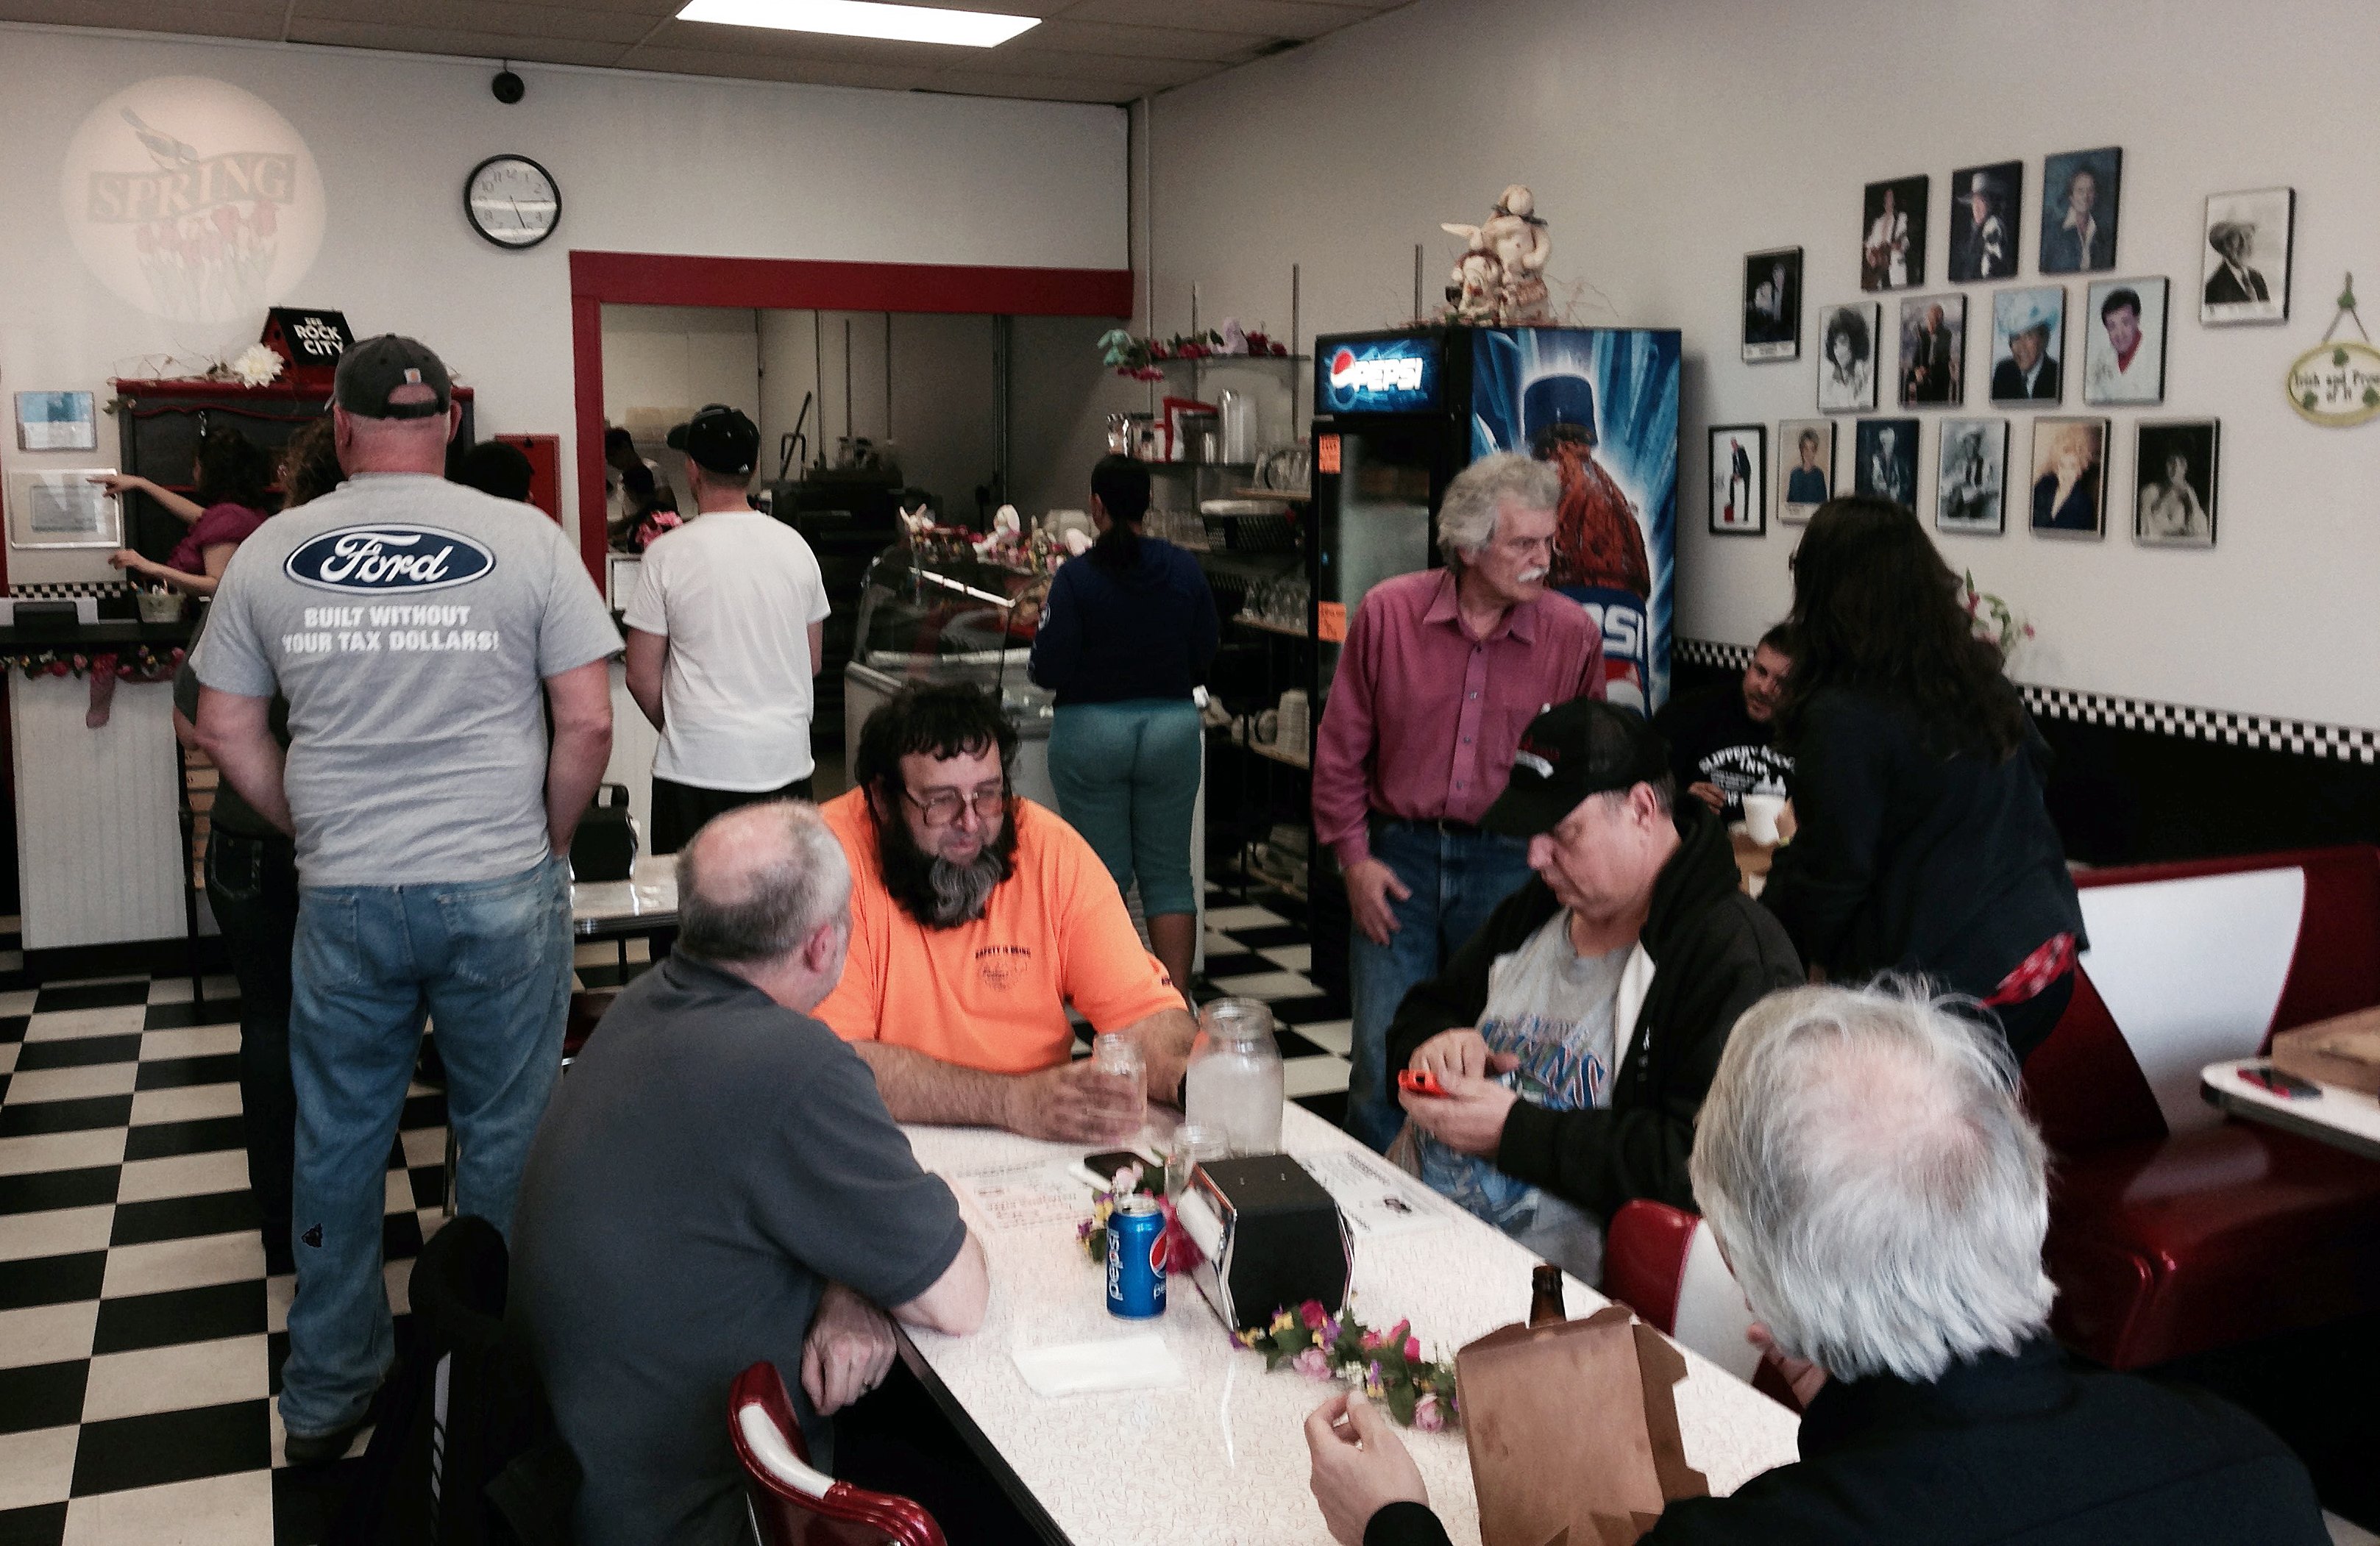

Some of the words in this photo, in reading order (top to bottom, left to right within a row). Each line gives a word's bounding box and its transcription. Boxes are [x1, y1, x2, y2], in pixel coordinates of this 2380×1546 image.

[96, 157, 285, 219] SPRING
[294, 324, 342, 341] ROCK
[303, 339, 344, 356] CITY
[1352, 357, 1424, 393] PEPSI
[320, 532, 454, 583] Ford
[304, 606, 366, 628] BUILT
[369, 605, 472, 627] WITHOUT
[281, 631, 333, 654] YOUR
[338, 630, 381, 653] TAX
[388, 630, 500, 652] DOLLARS!
[1109, 1228, 1124, 1302] pepsi
